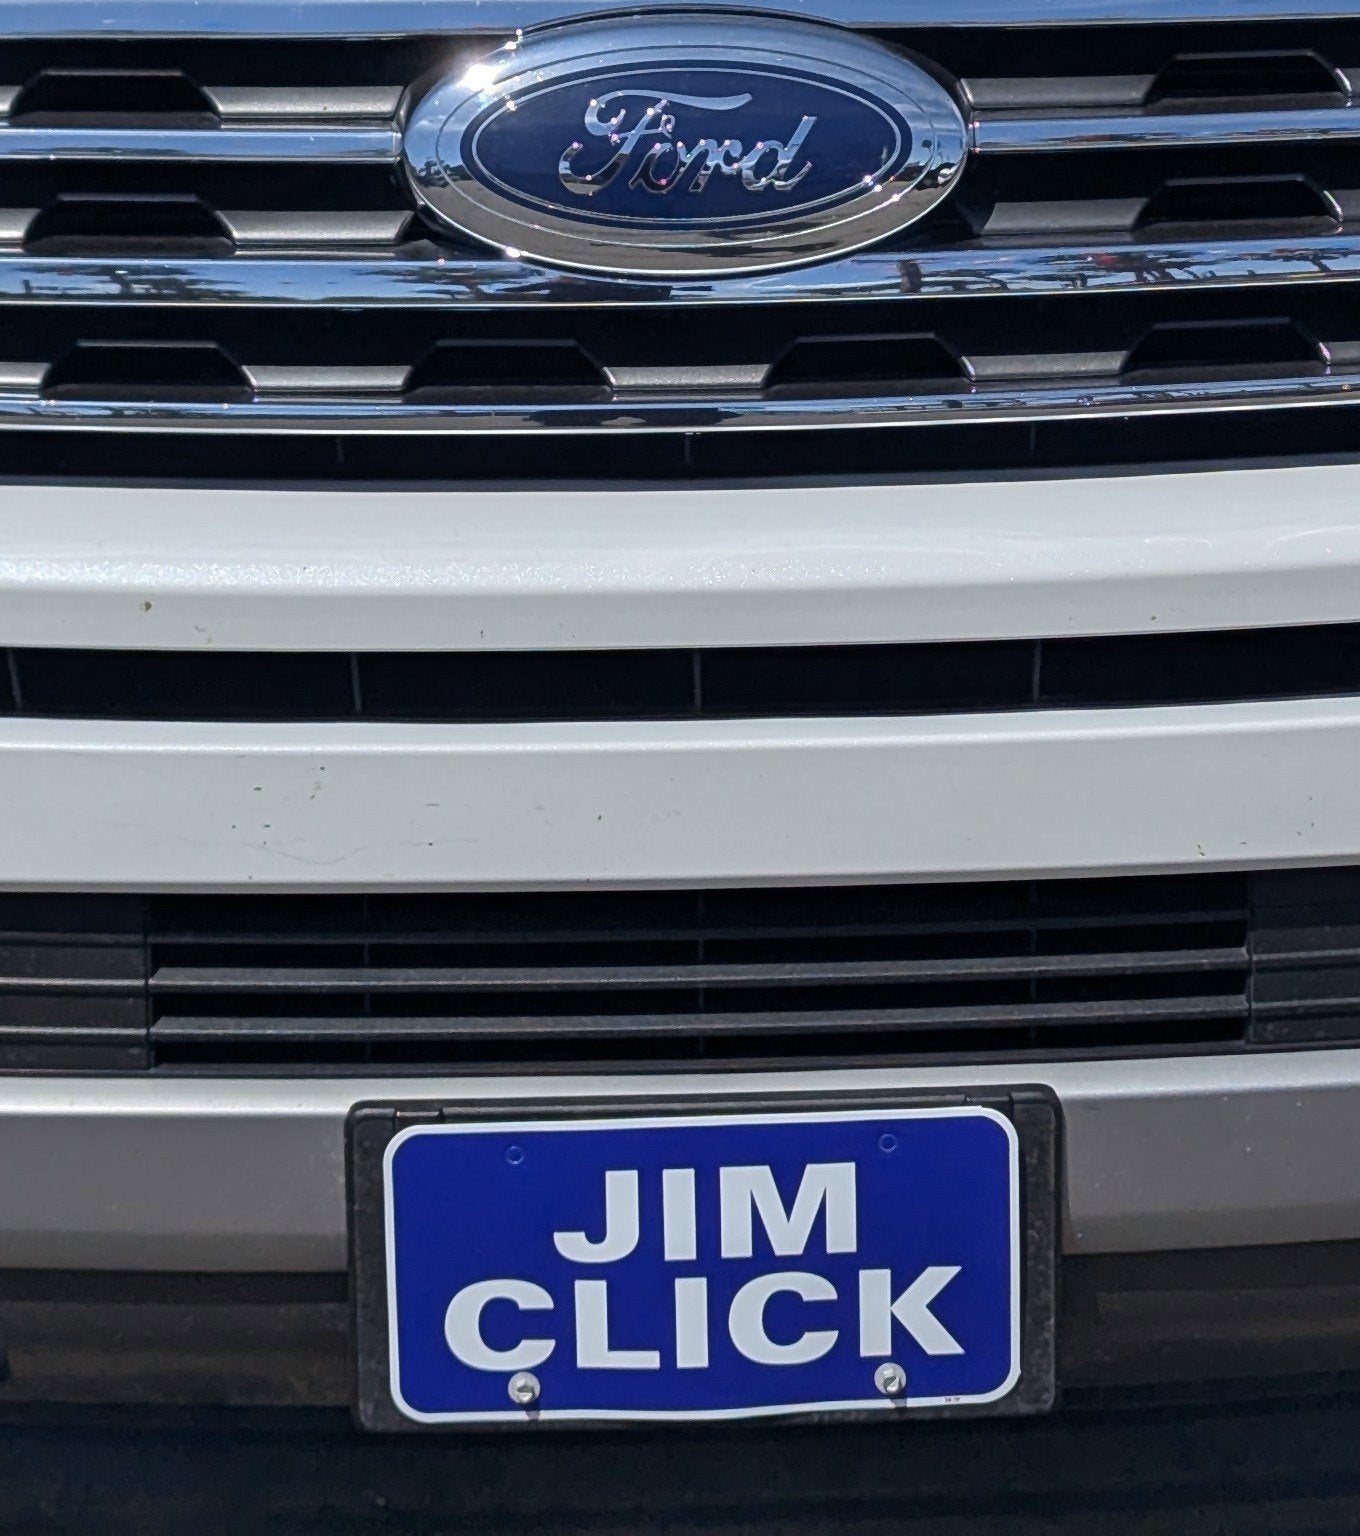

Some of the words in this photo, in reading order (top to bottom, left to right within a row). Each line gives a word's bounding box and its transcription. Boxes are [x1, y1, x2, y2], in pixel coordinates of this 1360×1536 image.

[558, 89, 818, 195] Ford
[553, 1161, 858, 1263] JIM
[444, 1265, 966, 1372] CLICK
